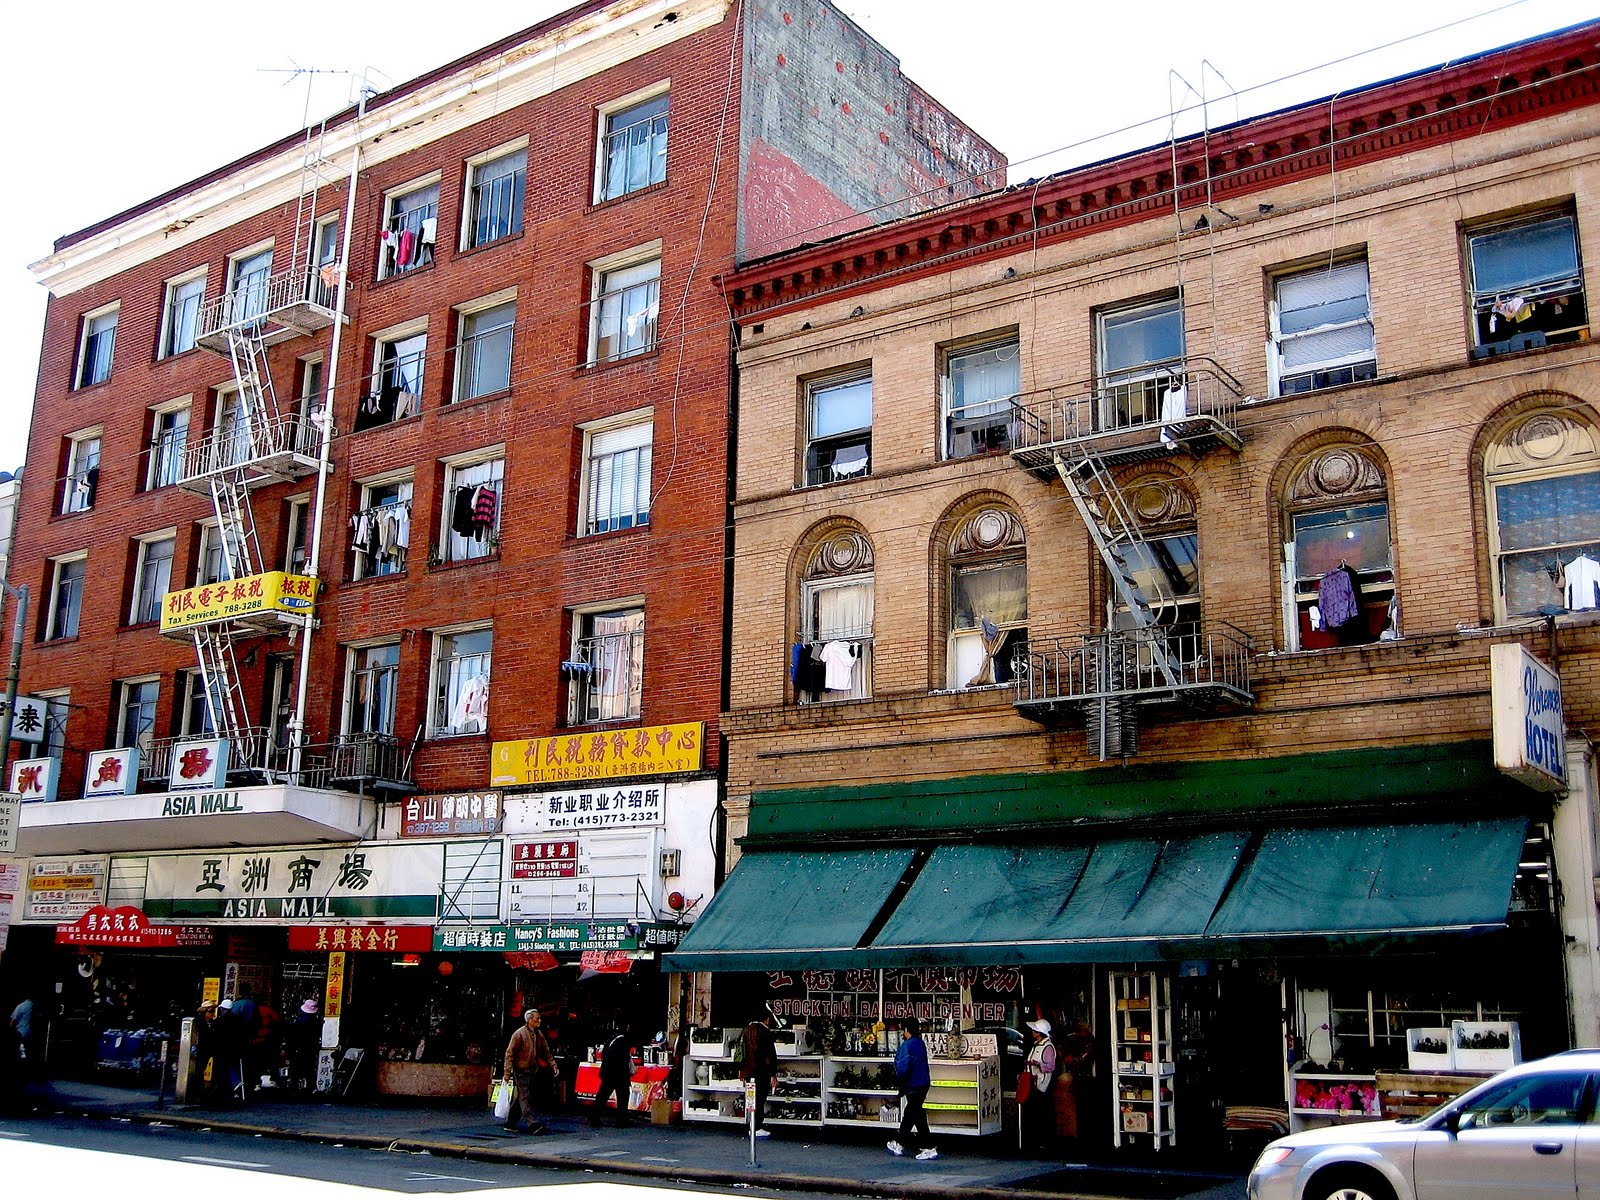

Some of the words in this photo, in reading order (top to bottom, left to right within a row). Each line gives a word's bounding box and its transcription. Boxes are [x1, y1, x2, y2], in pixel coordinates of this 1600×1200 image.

[168, 616, 182, 625] Tax
[186, 610, 219, 621] Services
[224, 600, 262, 614] 788-3288
[1525, 716, 1563, 777] HOTEL
[162, 796, 196, 817] ASIA
[200, 792, 244, 814] MALL
[548, 788, 660, 815] 新业职业介绍所
[548, 816, 570, 827] Tel:
[573, 811, 660, 827] (415)773-2321
[195, 853, 373, 893] 亞洲商場
[223, 898, 268, 918] ASIA
[280, 897, 336, 918] MALL
[442, 930, 507, 948] 超值時裝店
[547, 926, 580, 939] Fashions
[534, 942, 555, 950] Stockton
[773, 998, 851, 1018] STOCKTON
[860, 1000, 933, 1019] BARGAIN
[940, 1002, 1006, 1022] CENTER
